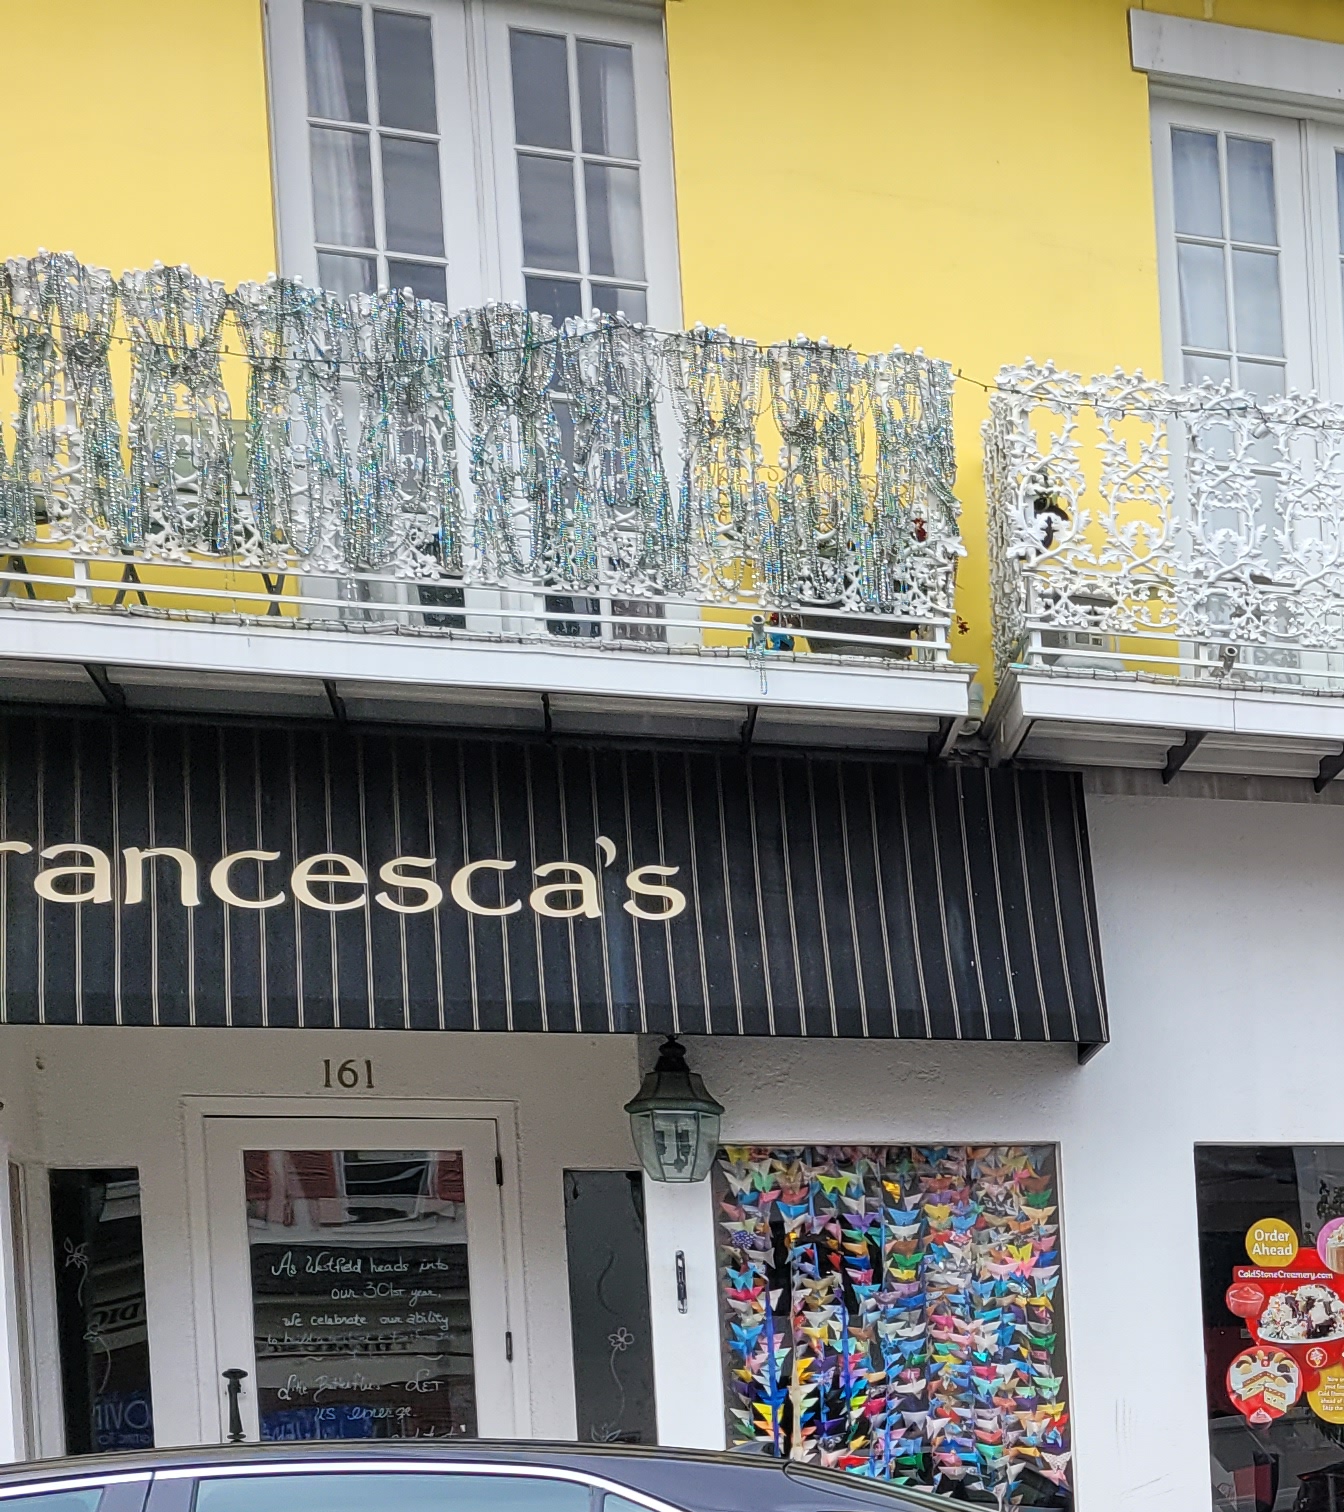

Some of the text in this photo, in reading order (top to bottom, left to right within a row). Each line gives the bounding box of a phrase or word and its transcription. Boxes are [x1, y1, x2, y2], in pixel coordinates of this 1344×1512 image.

[322, 1059, 375, 1089] 161
[1254, 1229, 1290, 1242] Order
[1252, 1243, 1293, 1256] Ahead
[271, 1251, 449, 1277] As Westfield heads into
[1238, 1269, 1333, 1281] ColdStoneCreamery.com
[311, 1313, 368, 1326] celebrate
[407, 1311, 449, 1330] ability
